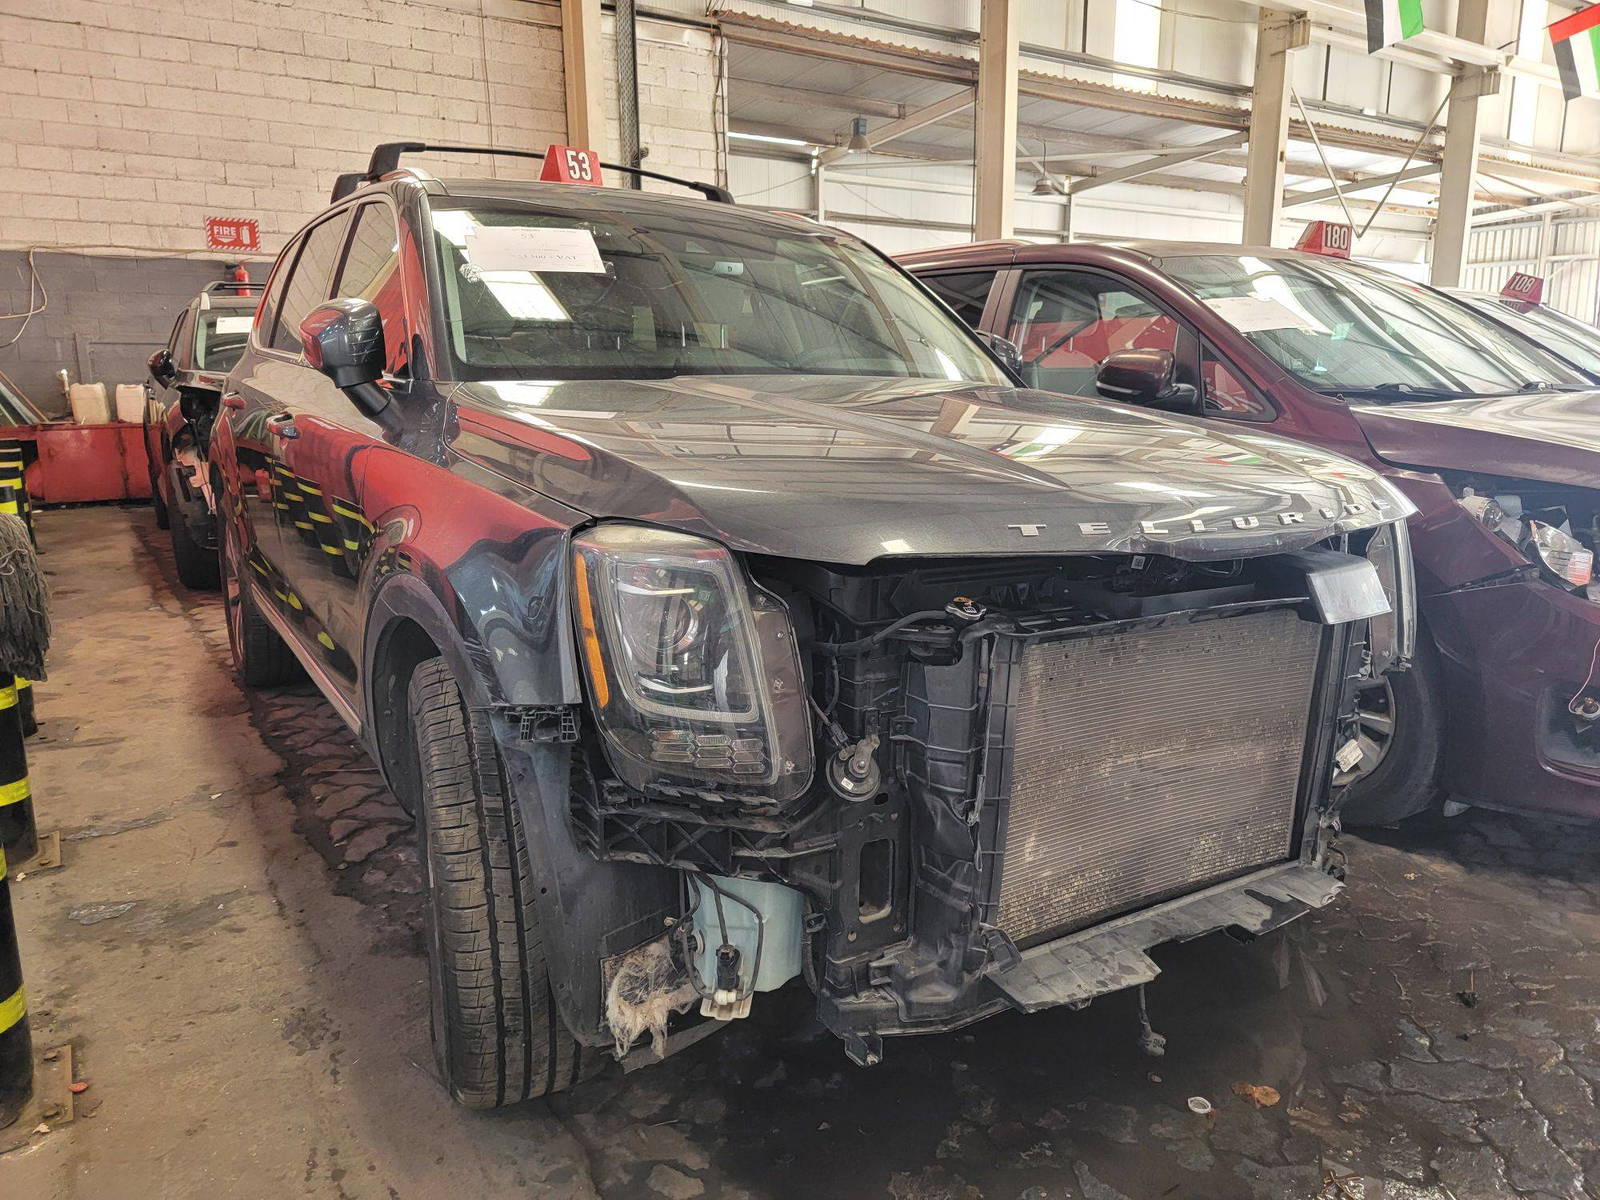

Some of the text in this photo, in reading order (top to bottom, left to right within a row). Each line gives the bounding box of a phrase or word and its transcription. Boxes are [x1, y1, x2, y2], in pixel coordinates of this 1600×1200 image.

[566, 149, 592, 181] 53
[213, 225, 237, 236] FIRE
[1326, 224, 1348, 250] 180
[1509, 275, 1536, 293] 108
[1007, 499, 1391, 537] TELLURIDE
